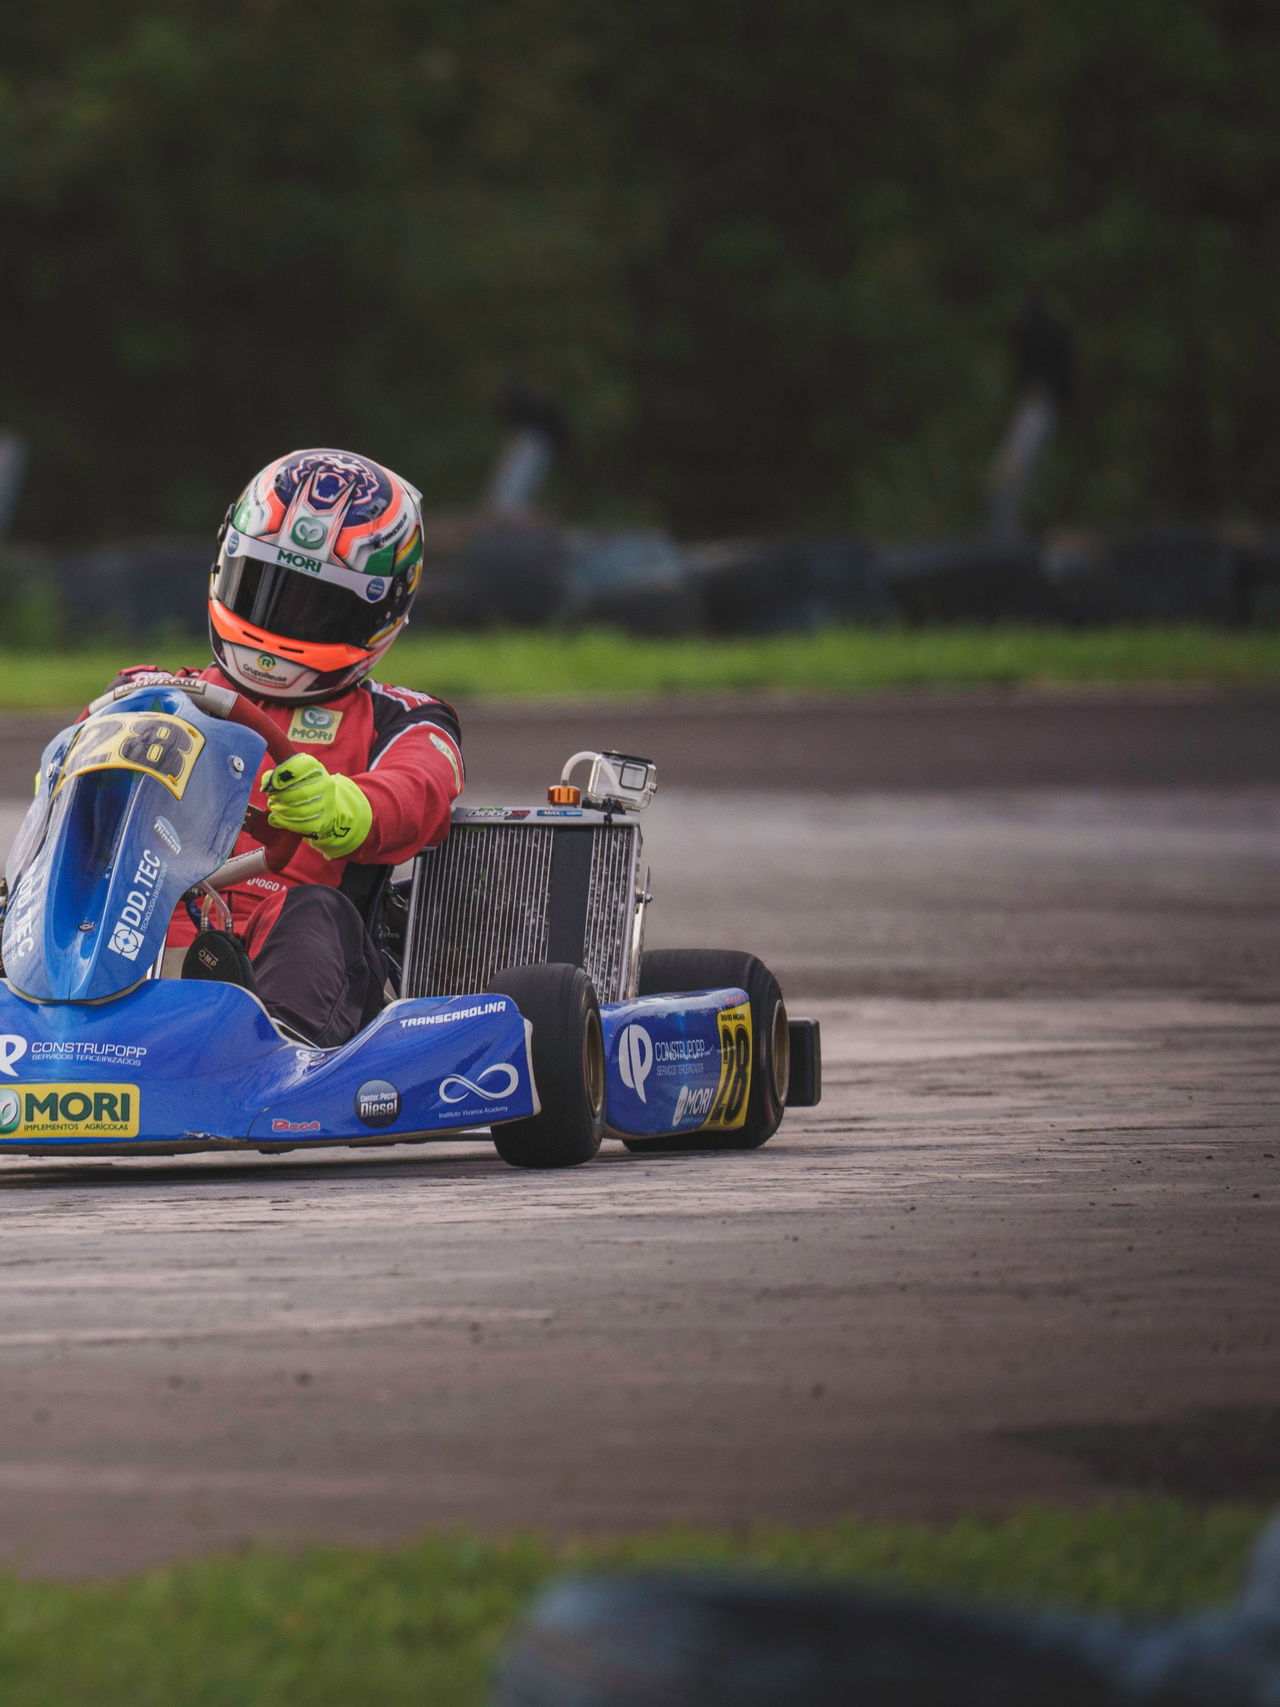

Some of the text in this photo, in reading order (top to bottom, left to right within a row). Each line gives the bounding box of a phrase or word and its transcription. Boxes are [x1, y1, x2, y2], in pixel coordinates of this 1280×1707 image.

[277, 549, 322, 573] MORI
[243, 663, 287, 682] GrupoReuse
[291, 727, 333, 741] MORI
[65, 718, 193, 780] 28
[120, 849, 161, 928] DD.TEC
[140, 897, 157, 932] TECNOLOGIA
[152, 890, 159, 899] EM
[198, 949, 217, 967] OMP
[399, 1000, 507, 1028] TRANSCAROLINA
[31, 1042, 147, 1058] CONSTRUPOPP
[655, 1039, 705, 1061] CONSTRUPOPP
[708, 1024, 751, 1124] 28
[25, 1092, 130, 1122] MORI
[360, 1099, 398, 1118] Diesel
[439, 1111, 461, 1119] Instituto
[484, 1105, 508, 1114] Academy
[683, 1088, 713, 1115] MORI
[24, 1122, 129, 1132] IMPLEMENTOS AGRÍCOLAS
